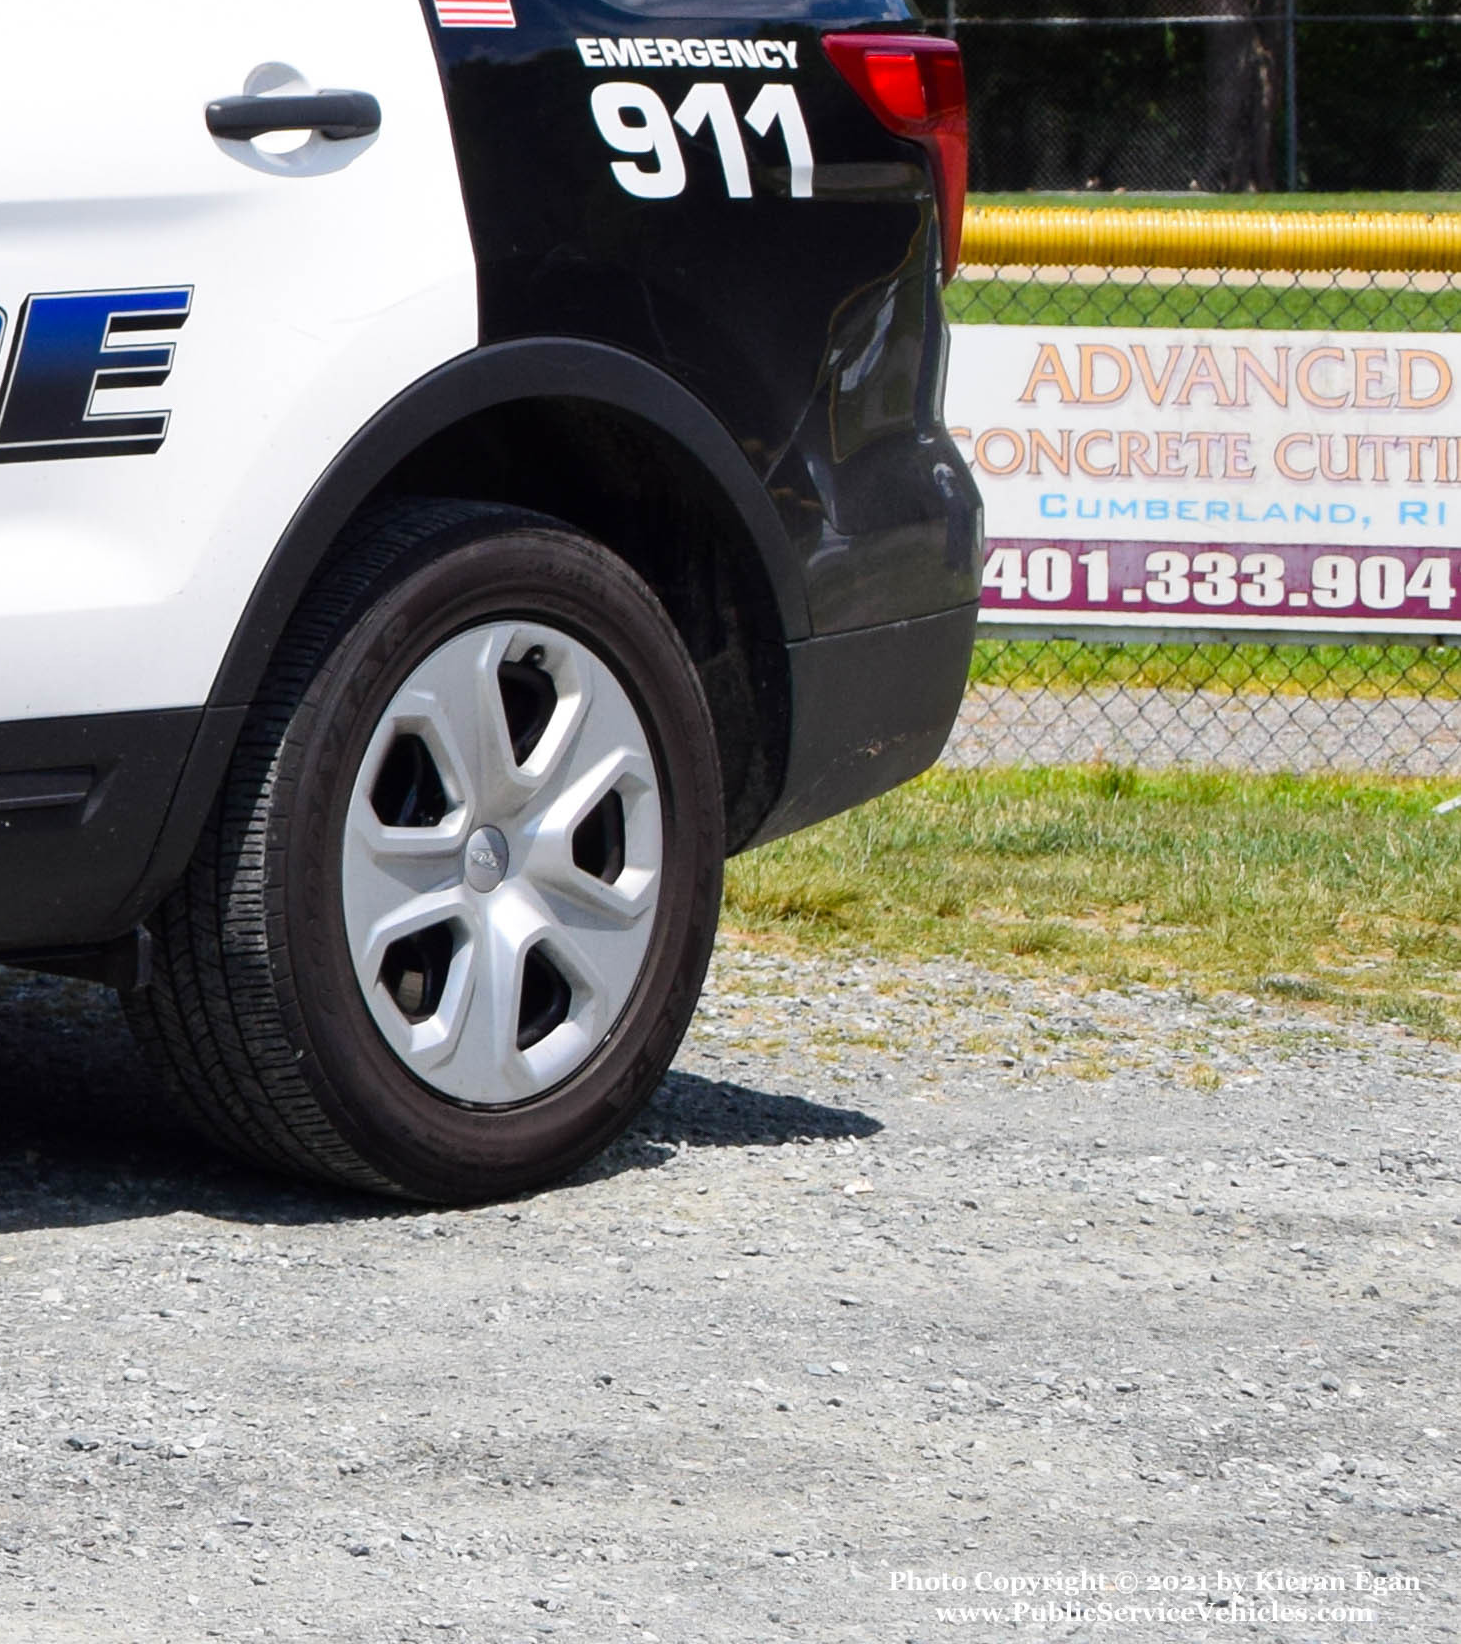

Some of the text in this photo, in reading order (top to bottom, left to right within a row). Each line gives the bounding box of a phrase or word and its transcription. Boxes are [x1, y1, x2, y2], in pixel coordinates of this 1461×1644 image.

[575, 37, 798, 69] EMERGENCY
[589, 81, 814, 199] 911
[1018, 342, 1453, 409] ADVANCED
[1274, 432, 1461, 484] CUTTI
[1399, 501, 1445, 525] RI
[982, 546, 1456, 610] 401.333.904
